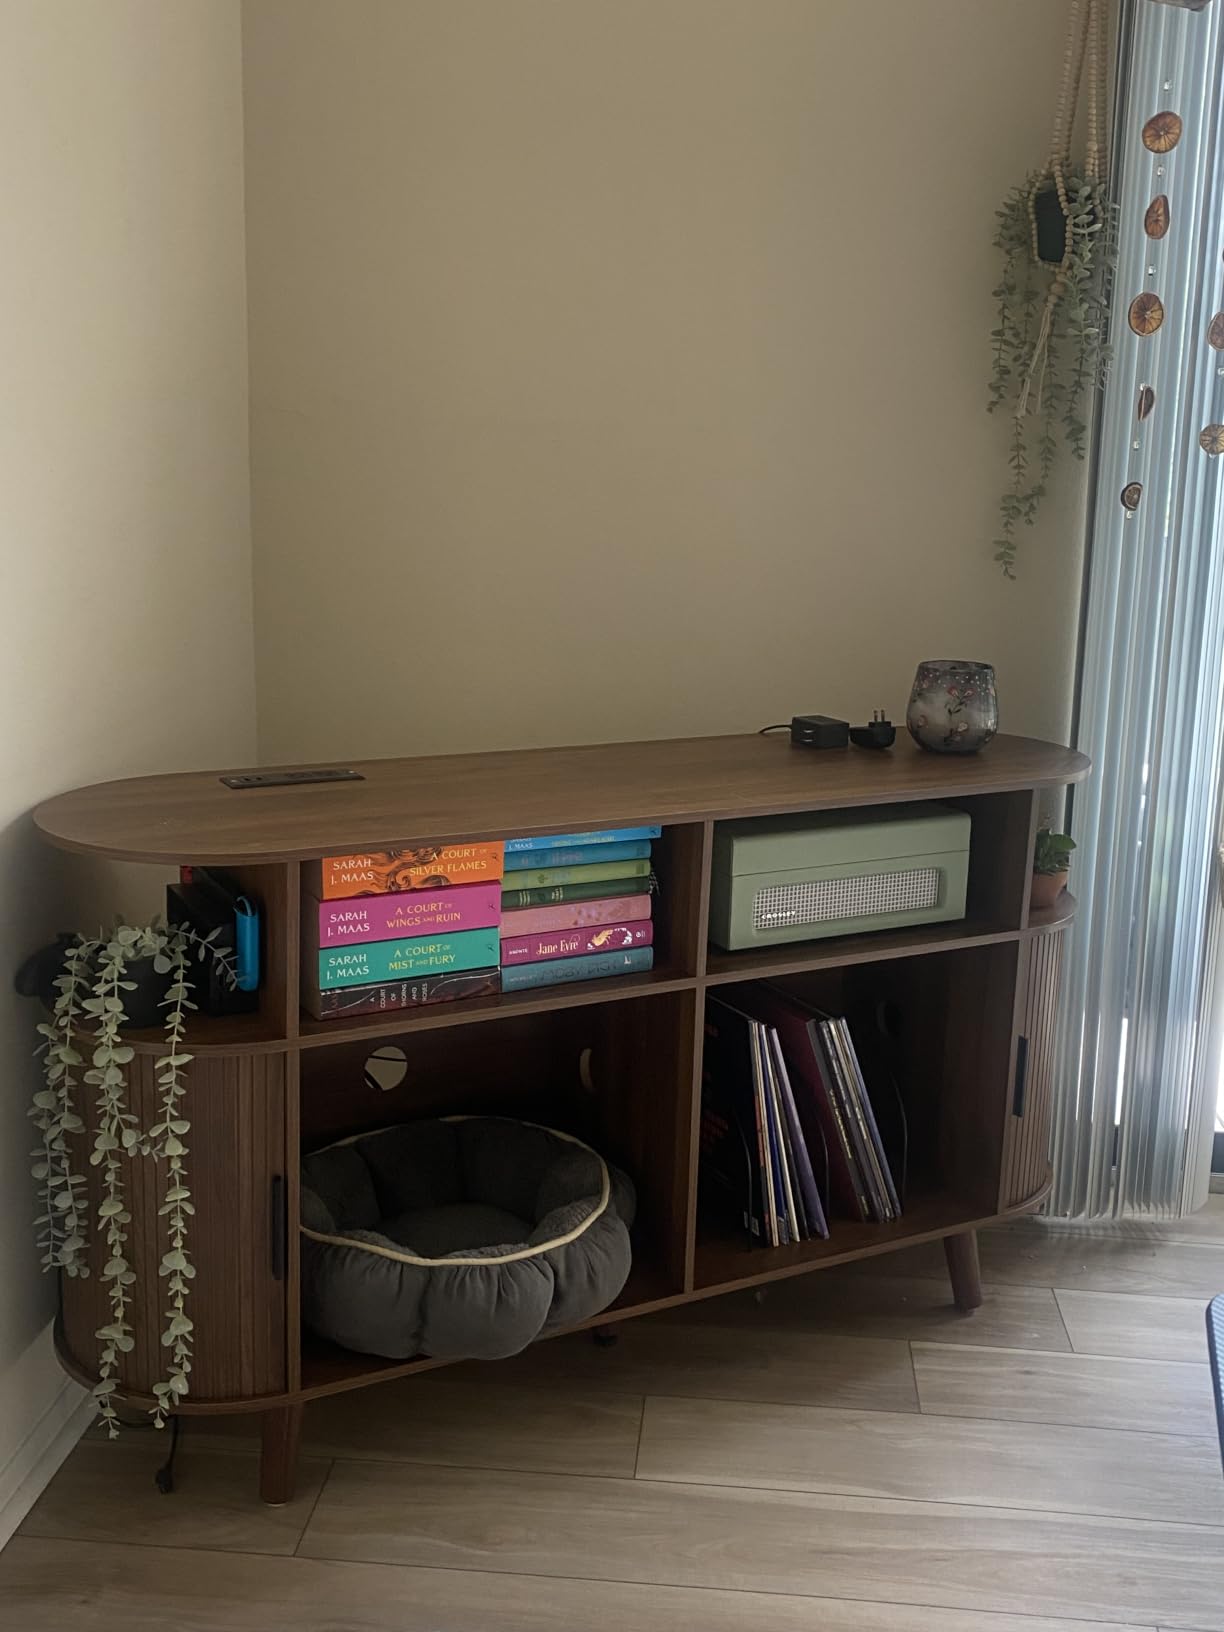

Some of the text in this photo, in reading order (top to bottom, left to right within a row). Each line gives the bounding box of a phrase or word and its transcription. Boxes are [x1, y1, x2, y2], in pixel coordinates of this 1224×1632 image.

[431, 852, 439, 860] A
[442, 848, 476, 860] COURT
[333, 858, 371, 870] SARAH
[409, 860, 487, 876] SILVER FLAMES
[341, 871, 374, 882] MAAS
[396, 907, 403, 916] A
[407, 902, 443, 914] COURT
[330, 910, 367, 923] SARAH
[386, 916, 422, 929] WINGS
[436, 912, 462, 923] RUIN
[338, 922, 370, 934] MAAS
[394, 950, 402, 958] A
[405, 944, 442, 956] COURT
[536, 942, 558, 956] Jane
[328, 954, 367, 966] SARAH
[388, 959, 414, 971] MIST
[429, 954, 456, 966] FURY
[336, 966, 370, 978] MAAS
[391, 992, 396, 1001] OF
